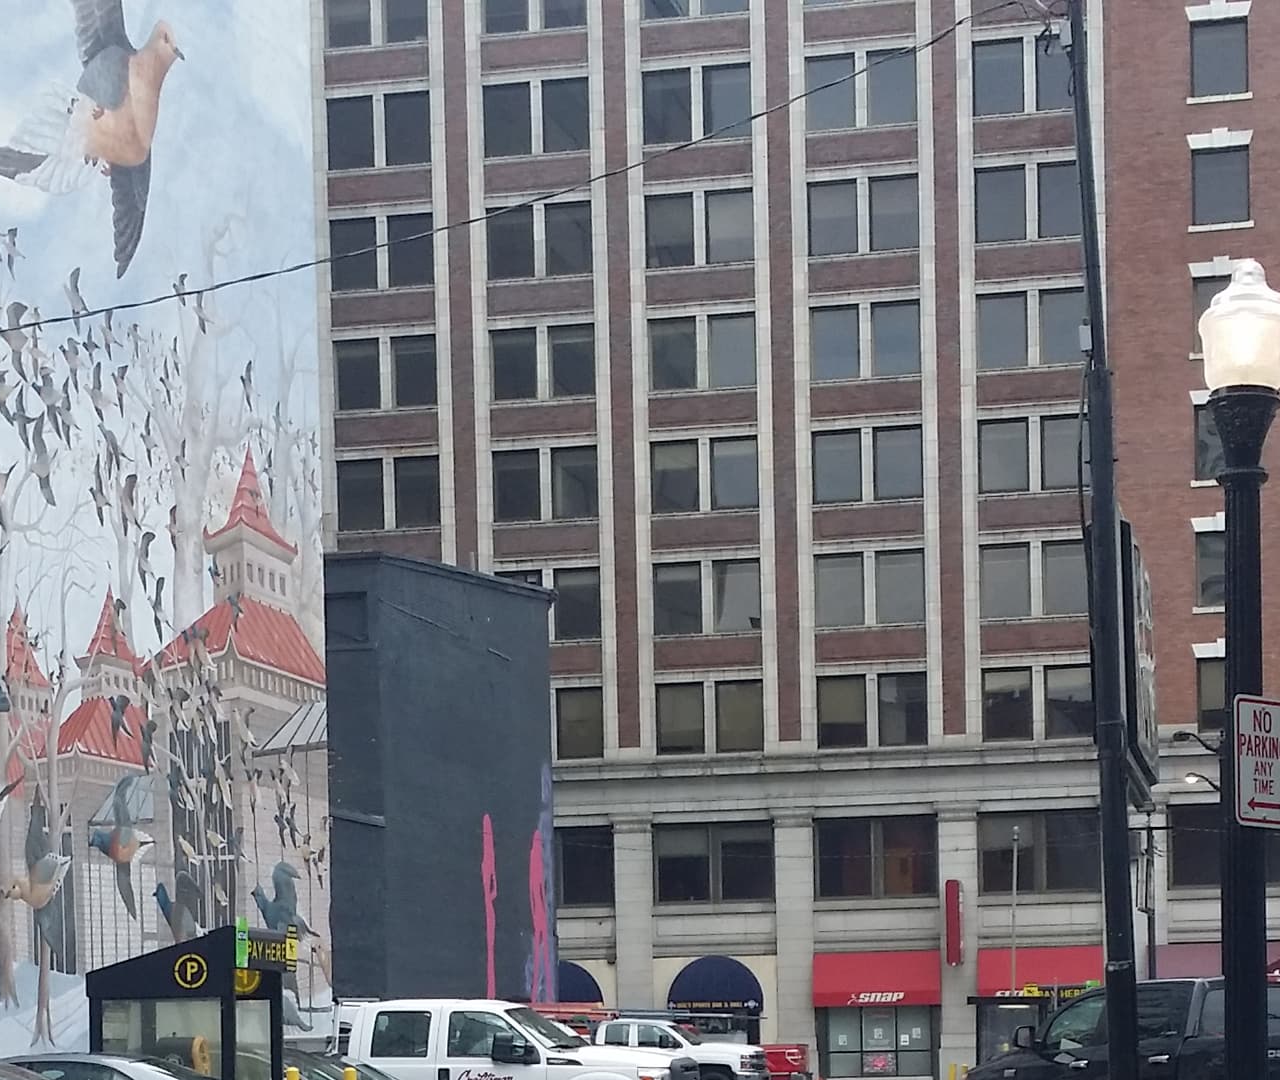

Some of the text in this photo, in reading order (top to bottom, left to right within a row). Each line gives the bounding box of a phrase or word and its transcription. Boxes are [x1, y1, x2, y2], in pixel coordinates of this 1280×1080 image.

[1253, 709, 1272, 734] NO
[1254, 760, 1274, 777] ANY
[1253, 778, 1275, 796] TIME
[247, 940, 287, 962] PAY HERE
[186, 961, 199, 982] P
[858, 991, 905, 1003] snap
